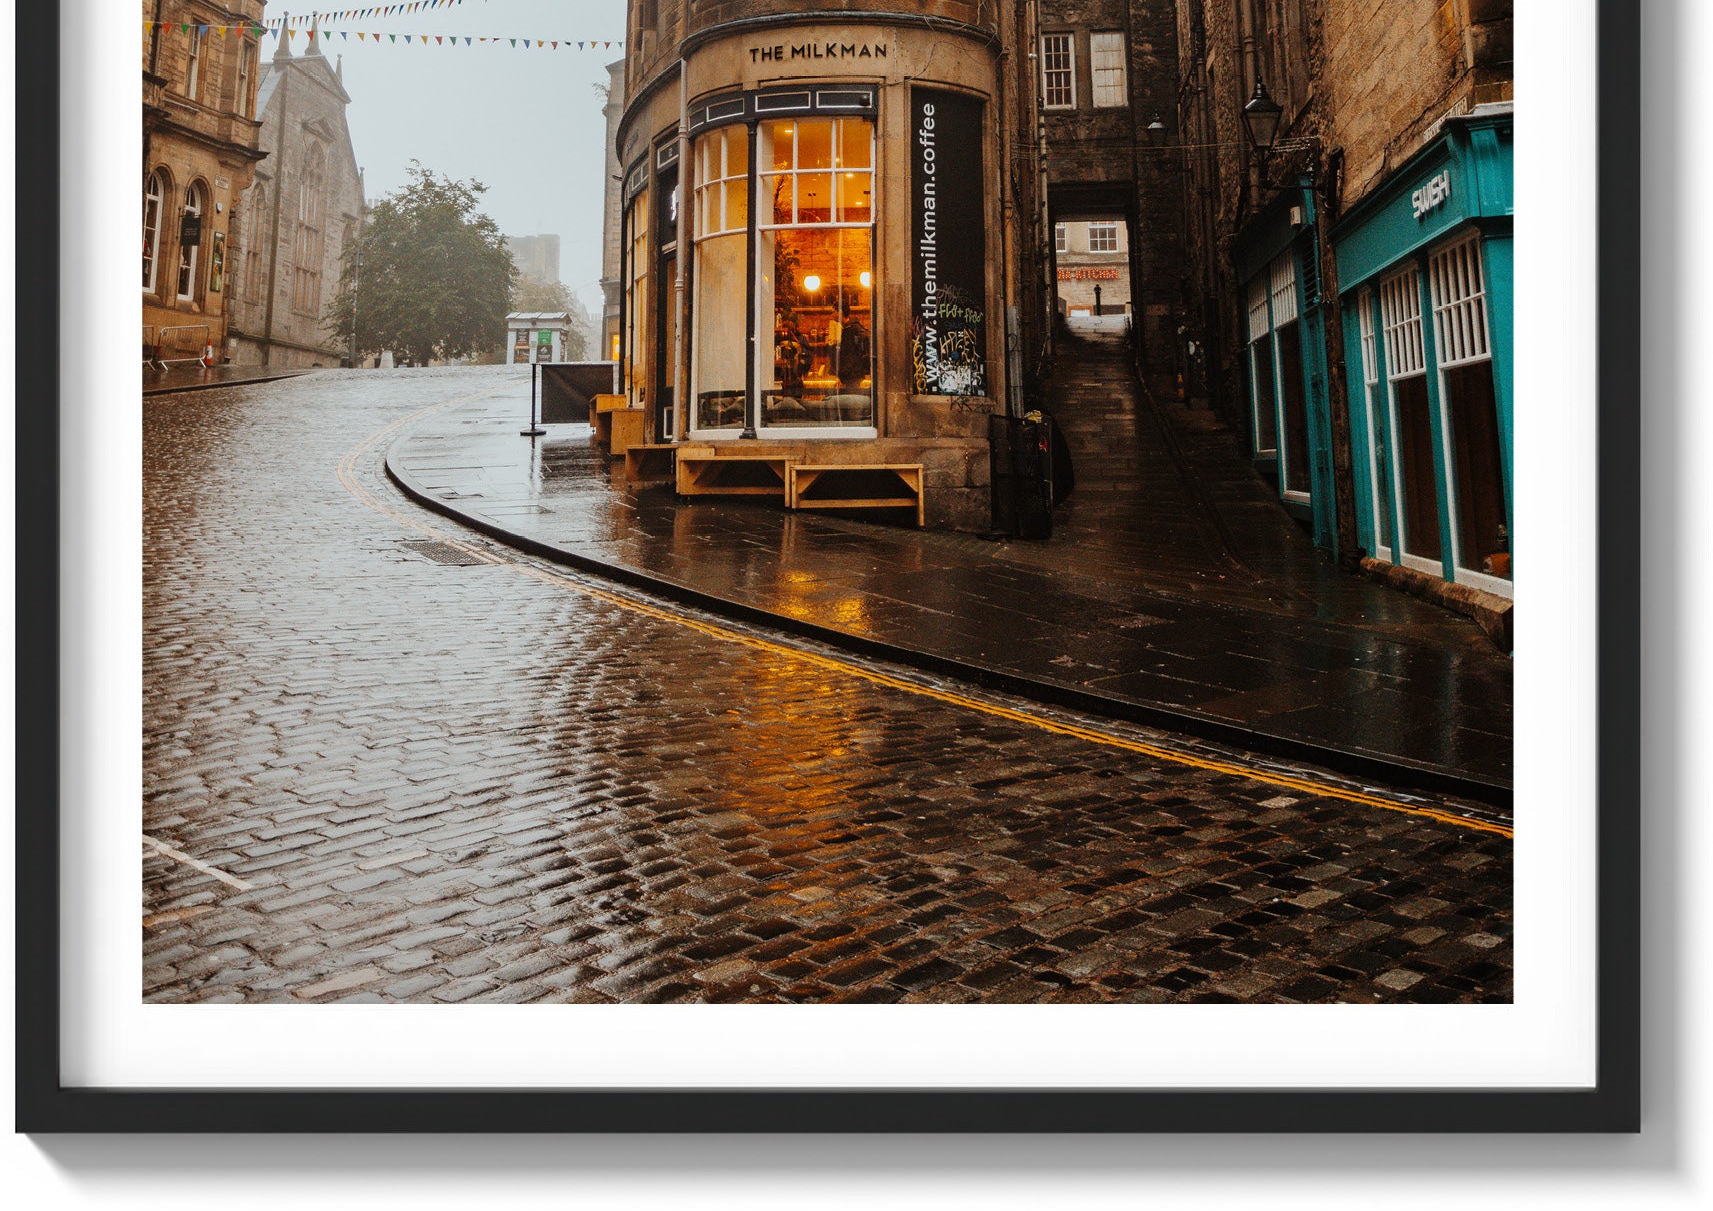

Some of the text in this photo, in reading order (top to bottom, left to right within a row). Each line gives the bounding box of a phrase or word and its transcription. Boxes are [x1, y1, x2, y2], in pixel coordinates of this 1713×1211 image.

[749, 42, 887, 63] THE MILKMAN
[1411, 169, 1451, 219] SWISH
[919, 103, 938, 383] www.themilkman.coffee
